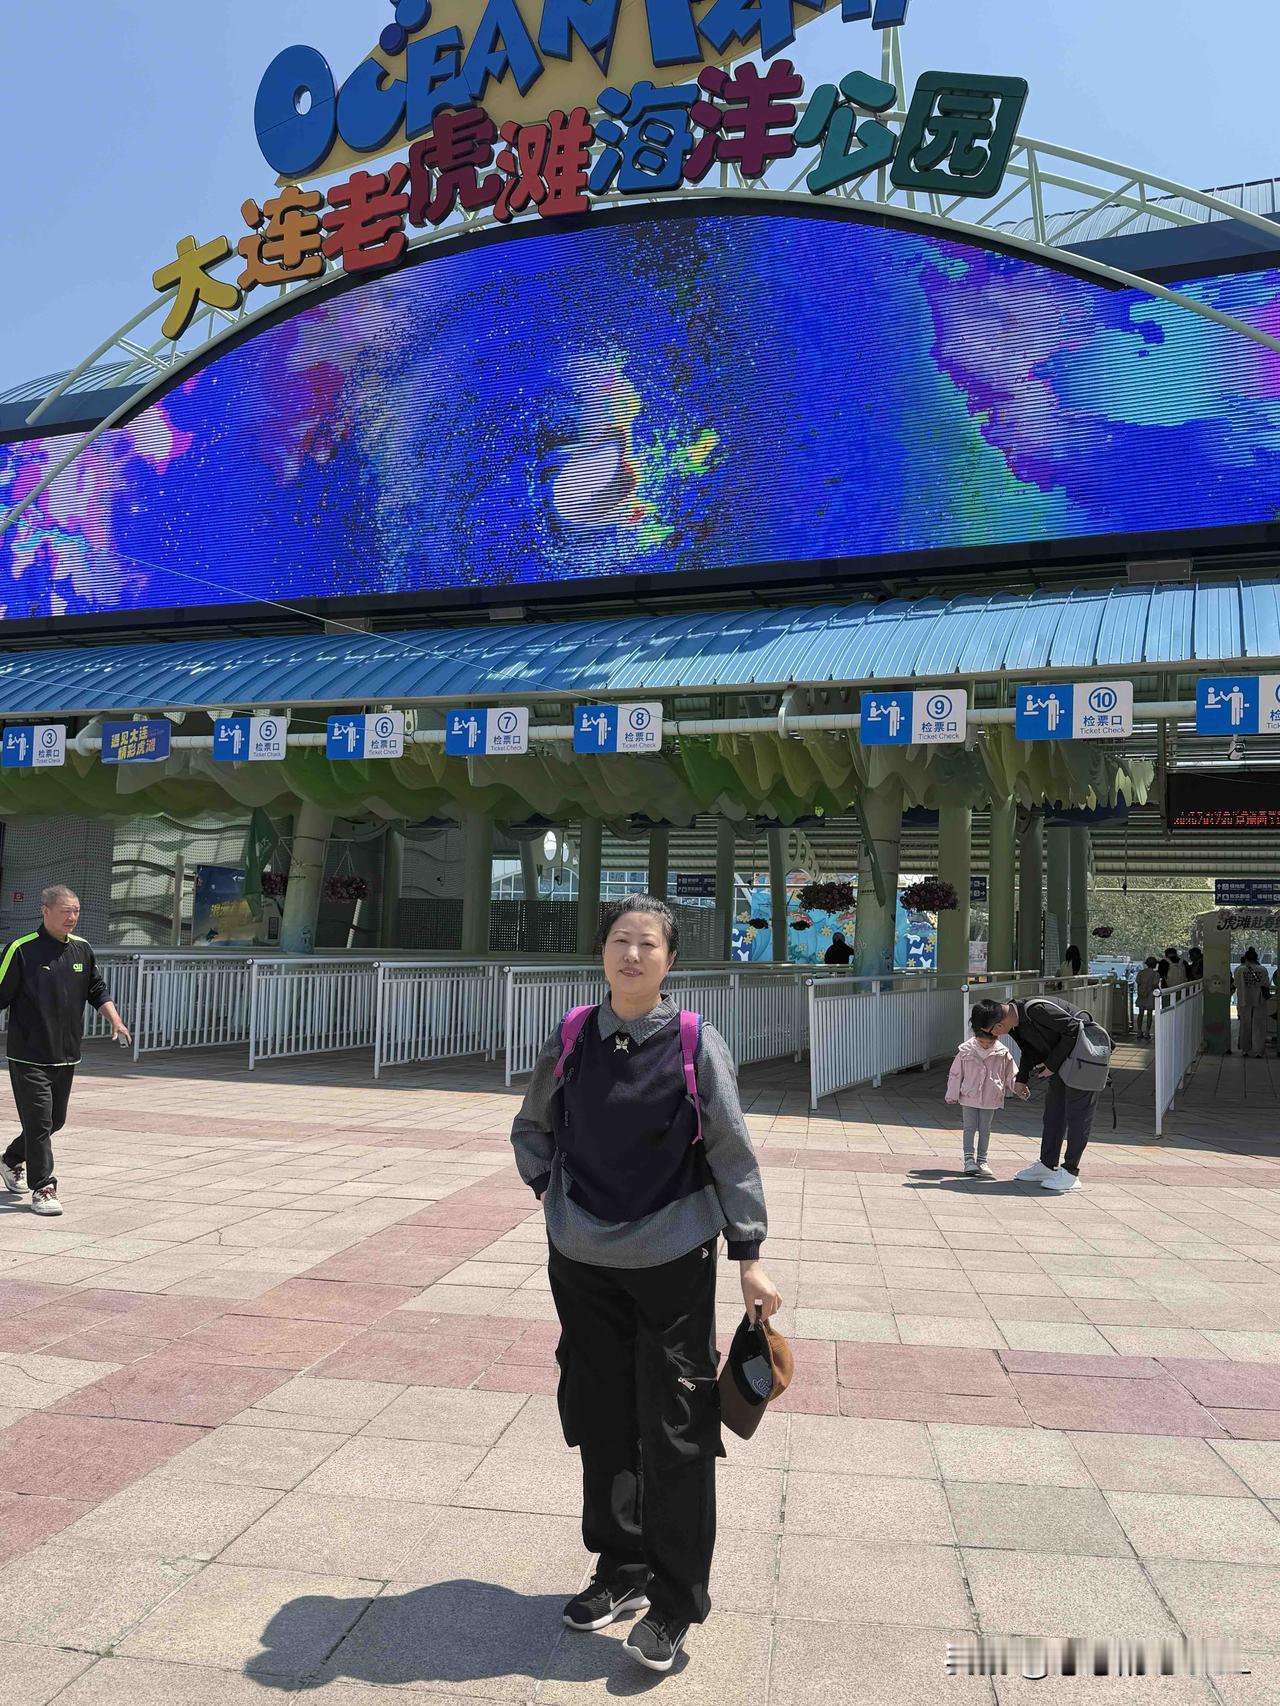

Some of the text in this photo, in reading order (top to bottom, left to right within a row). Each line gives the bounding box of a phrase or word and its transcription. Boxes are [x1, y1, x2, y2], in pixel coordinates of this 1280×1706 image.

[152, 59, 1029, 339] 大连老虎滩海洋公园
[1092, 692, 1111, 708] 10
[1083, 715, 1123, 727] 检票口
[921, 722, 958, 732] 检票口
[1103, 726, 1126, 734] Check
[494, 735, 520, 746] 检票口
[624, 732, 654, 742] 检票口
[938, 732, 960, 740] Check
[255, 742, 280, 752] 检票口
[371, 740, 398, 750] 检票口
[38, 749, 60, 758] 检票口
[1217, 915, 1280, 930] 虎滩赴春
